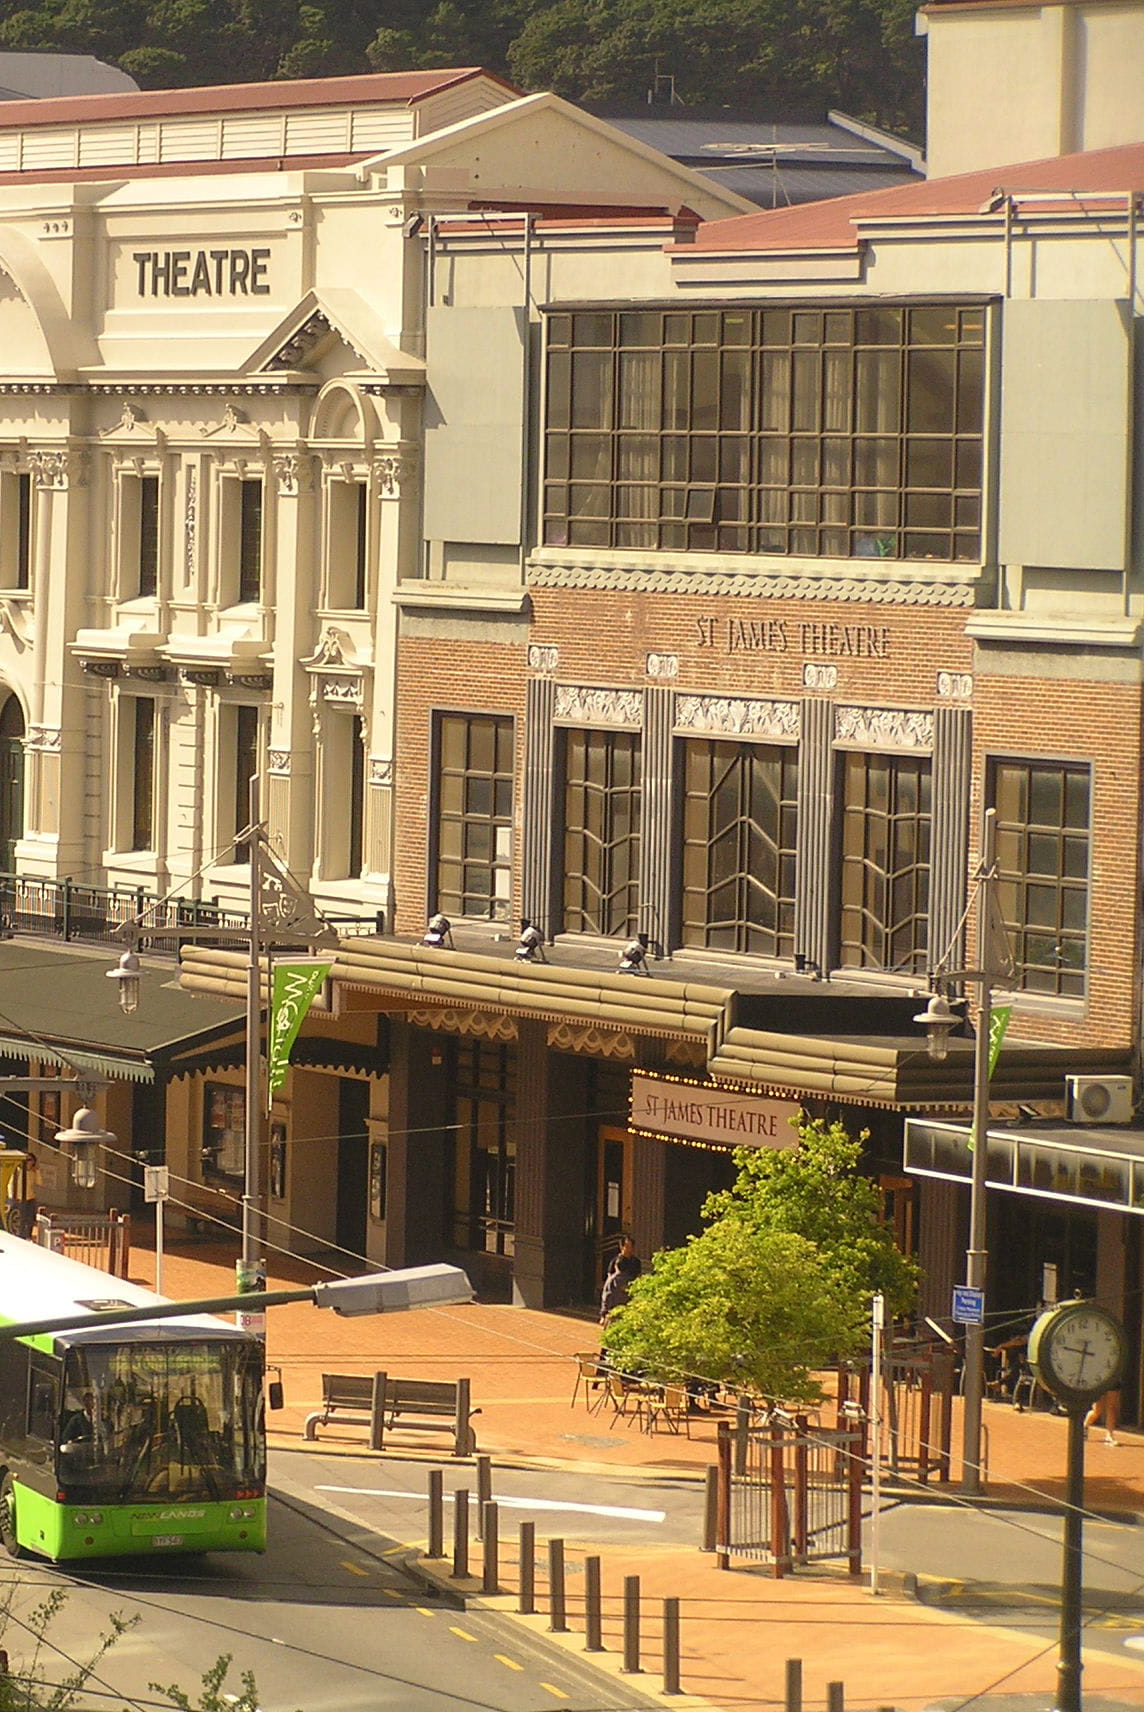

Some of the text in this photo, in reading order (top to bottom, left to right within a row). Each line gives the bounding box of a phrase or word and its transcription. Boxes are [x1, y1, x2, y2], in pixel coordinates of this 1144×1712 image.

[133, 248, 271, 297] THEATRE
[696, 615, 891, 659] ST JAMES THEATRE
[645, 1094, 778, 1137] ST JAMES THEATRE
